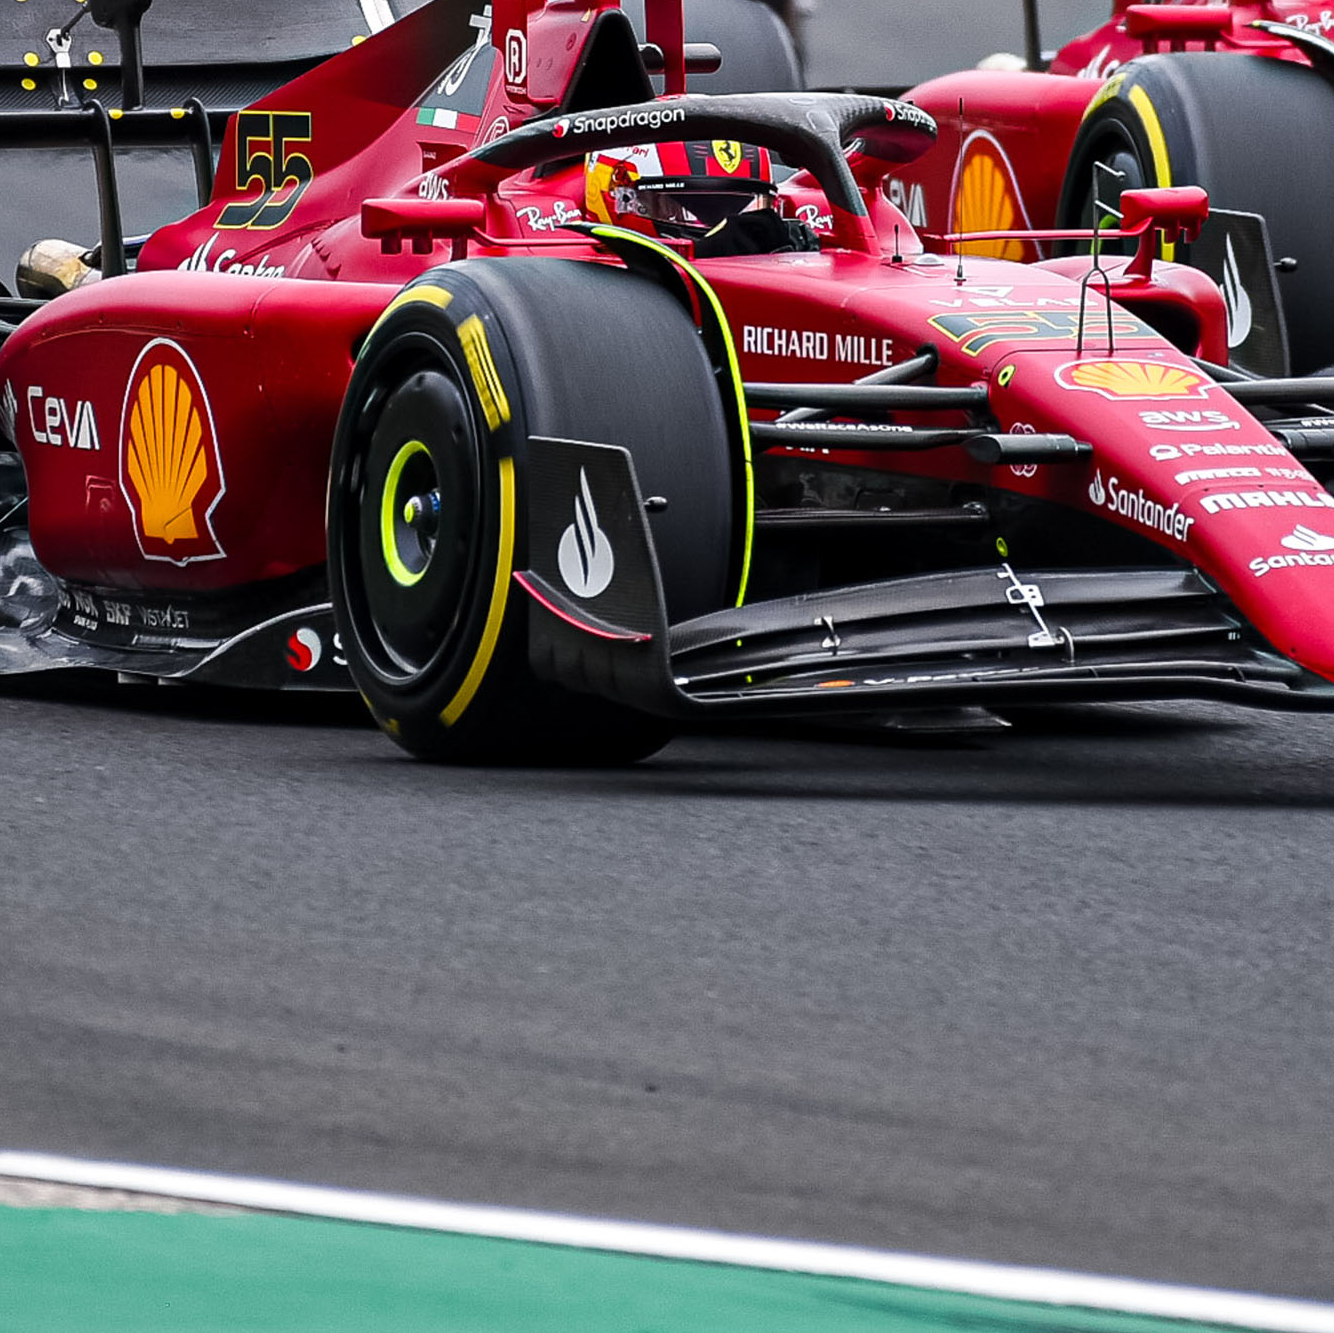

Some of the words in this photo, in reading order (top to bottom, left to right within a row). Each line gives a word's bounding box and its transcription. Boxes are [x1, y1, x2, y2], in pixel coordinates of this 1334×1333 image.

[572, 107, 686, 135] Snapdragon
[212, 110, 315, 231] 55
[516, 201, 582, 232] Ray-Ban
[742, 324, 829, 361] RICHARD
[835, 333, 893, 366] MILLE
[1138, 410, 1231, 424] aws
[1107, 476, 1196, 543] Santander
